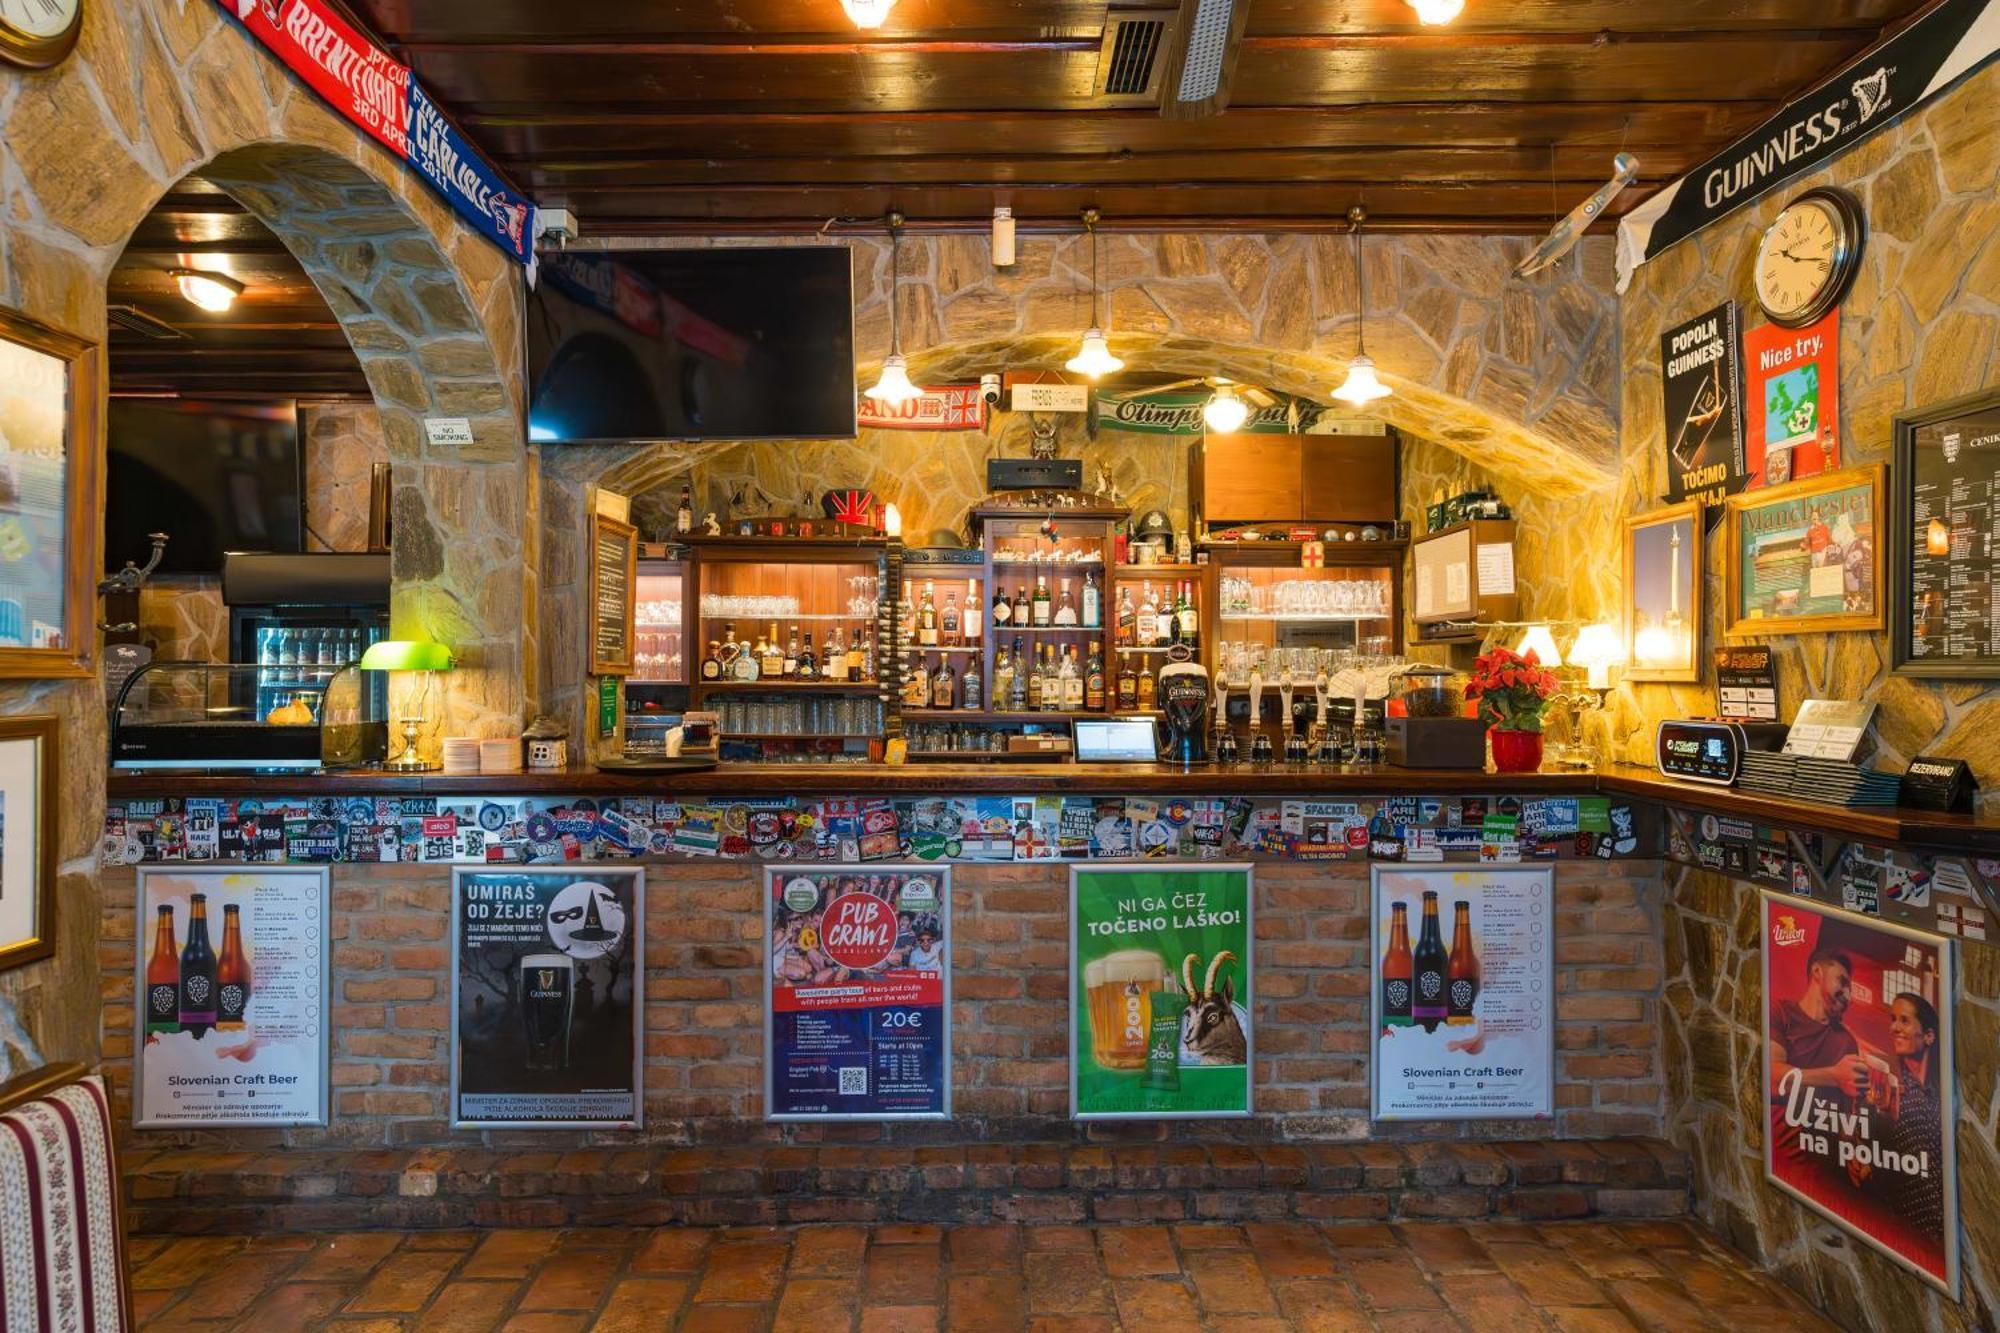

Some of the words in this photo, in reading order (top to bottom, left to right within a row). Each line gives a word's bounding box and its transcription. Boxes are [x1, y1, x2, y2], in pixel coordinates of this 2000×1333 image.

[366, 44, 388, 72] JPT
[388, 64, 411, 90] CUP
[413, 86, 449, 141] FINAL
[352, 94, 379, 128] 3RD
[382, 123, 419, 163] APRIL
[421, 154, 449, 192] 2011
[400, 95, 412, 131] V
[416, 109, 492, 217] CARLISLE
[1704, 100, 1842, 209] GUINNESS
[1672, 318, 1717, 355] POPOLN
[1668, 339, 1725, 379] GUINNESS
[1760, 346, 1792, 371] Nice
[1796, 334, 1824, 361] try.
[1682, 463, 1727, 490] TOČIMO
[1168, 688, 1206, 697] GUINNESS
[1392, 807, 1415, 815] ARE
[1392, 815, 1415, 825] YOU
[425, 846, 453, 857] ISIS
[468, 882, 535, 900] UMIRAŠ
[468, 904, 489, 919] OD
[494, 901, 545, 919] ŽEJE?
[840, 902, 879, 924] PUB
[1118, 899, 1136, 914] NI
[1141, 898, 1167, 911] GA
[1171, 892, 1207, 909] ČEZ
[1088, 916, 1167, 936] TOČENO
[1173, 909, 1241, 929] LAŠKO!
[1772, 924, 1805, 942] Union
[828, 922, 889, 946] CRAWL
[881, 1012, 922, 1027] 20€
[1151, 1049, 1175, 1060] 200
[168, 1075, 231, 1086] Slovenian
[234, 1074, 265, 1085] Craft
[269, 1074, 298, 1085] Beer
[1403, 1068, 1461, 1078] Slovenian
[1464, 1067, 1493, 1077] Craft
[1496, 1067, 1524, 1077] Beer
[1779, 1068, 1870, 1140] Uživi
[1799, 1131, 1829, 1155] na
[1839, 1139, 1929, 1178] polno!
